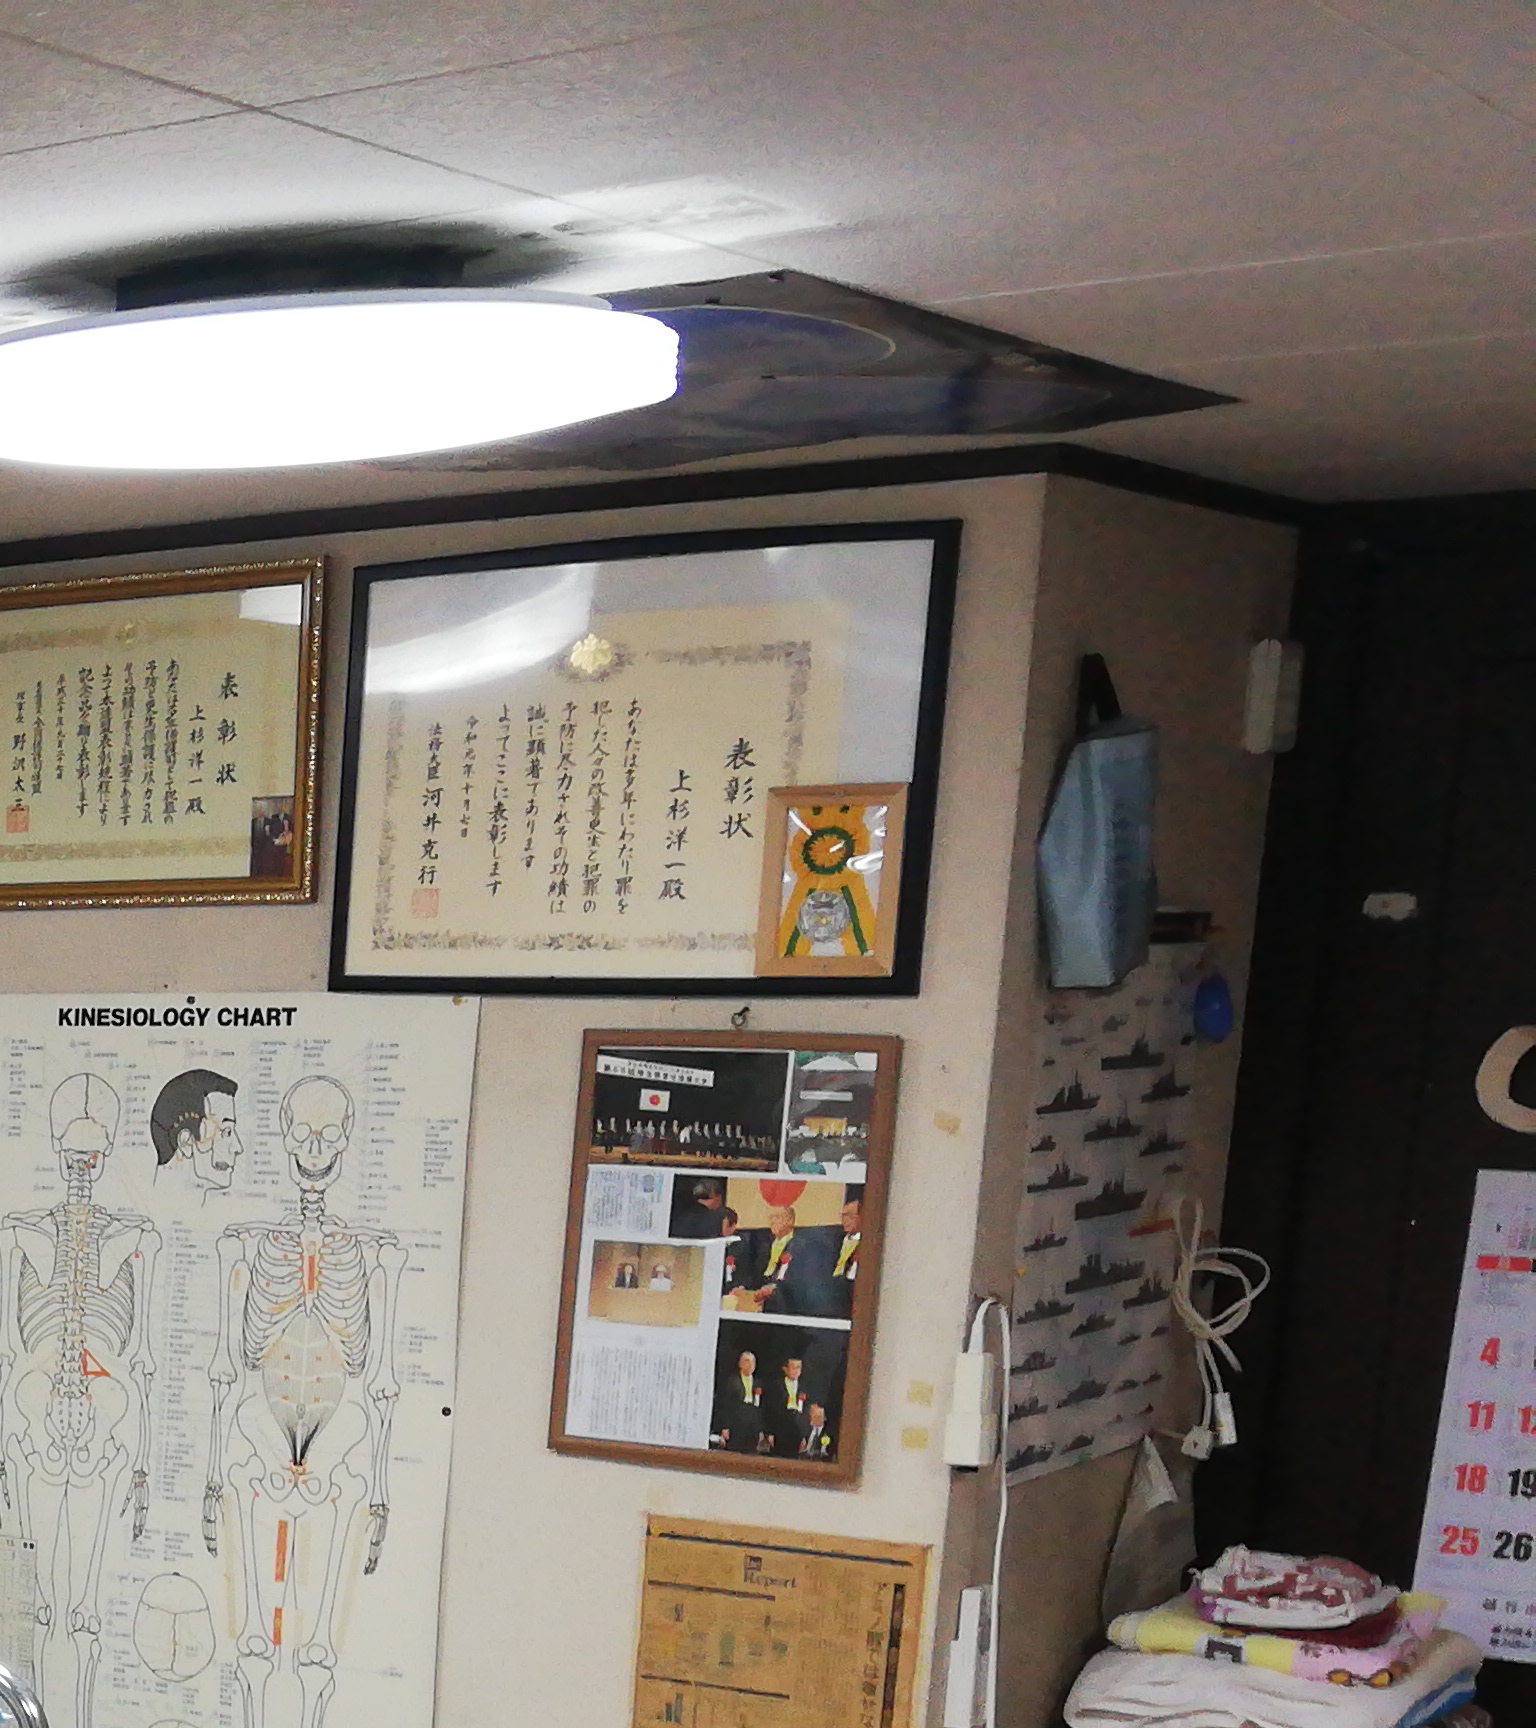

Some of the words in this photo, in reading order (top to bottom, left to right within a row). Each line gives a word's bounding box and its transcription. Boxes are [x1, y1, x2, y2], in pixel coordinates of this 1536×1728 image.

[215, 671, 240, 786] 表彰状
[718, 736, 757, 840] 表彰状
[658, 768, 693, 901] 上杉洋一殿
[57, 1006, 211, 1027] KINESIOLOGY
[216, 1006, 299, 1027] CHART
[1480, 1337, 1501, 1367] 4
[1467, 1400, 1496, 1431] 11
[1454, 1462, 1489, 1494] 18
[1439, 1524, 1481, 1556] 25
[1493, 1530, 1534, 1561] 26
